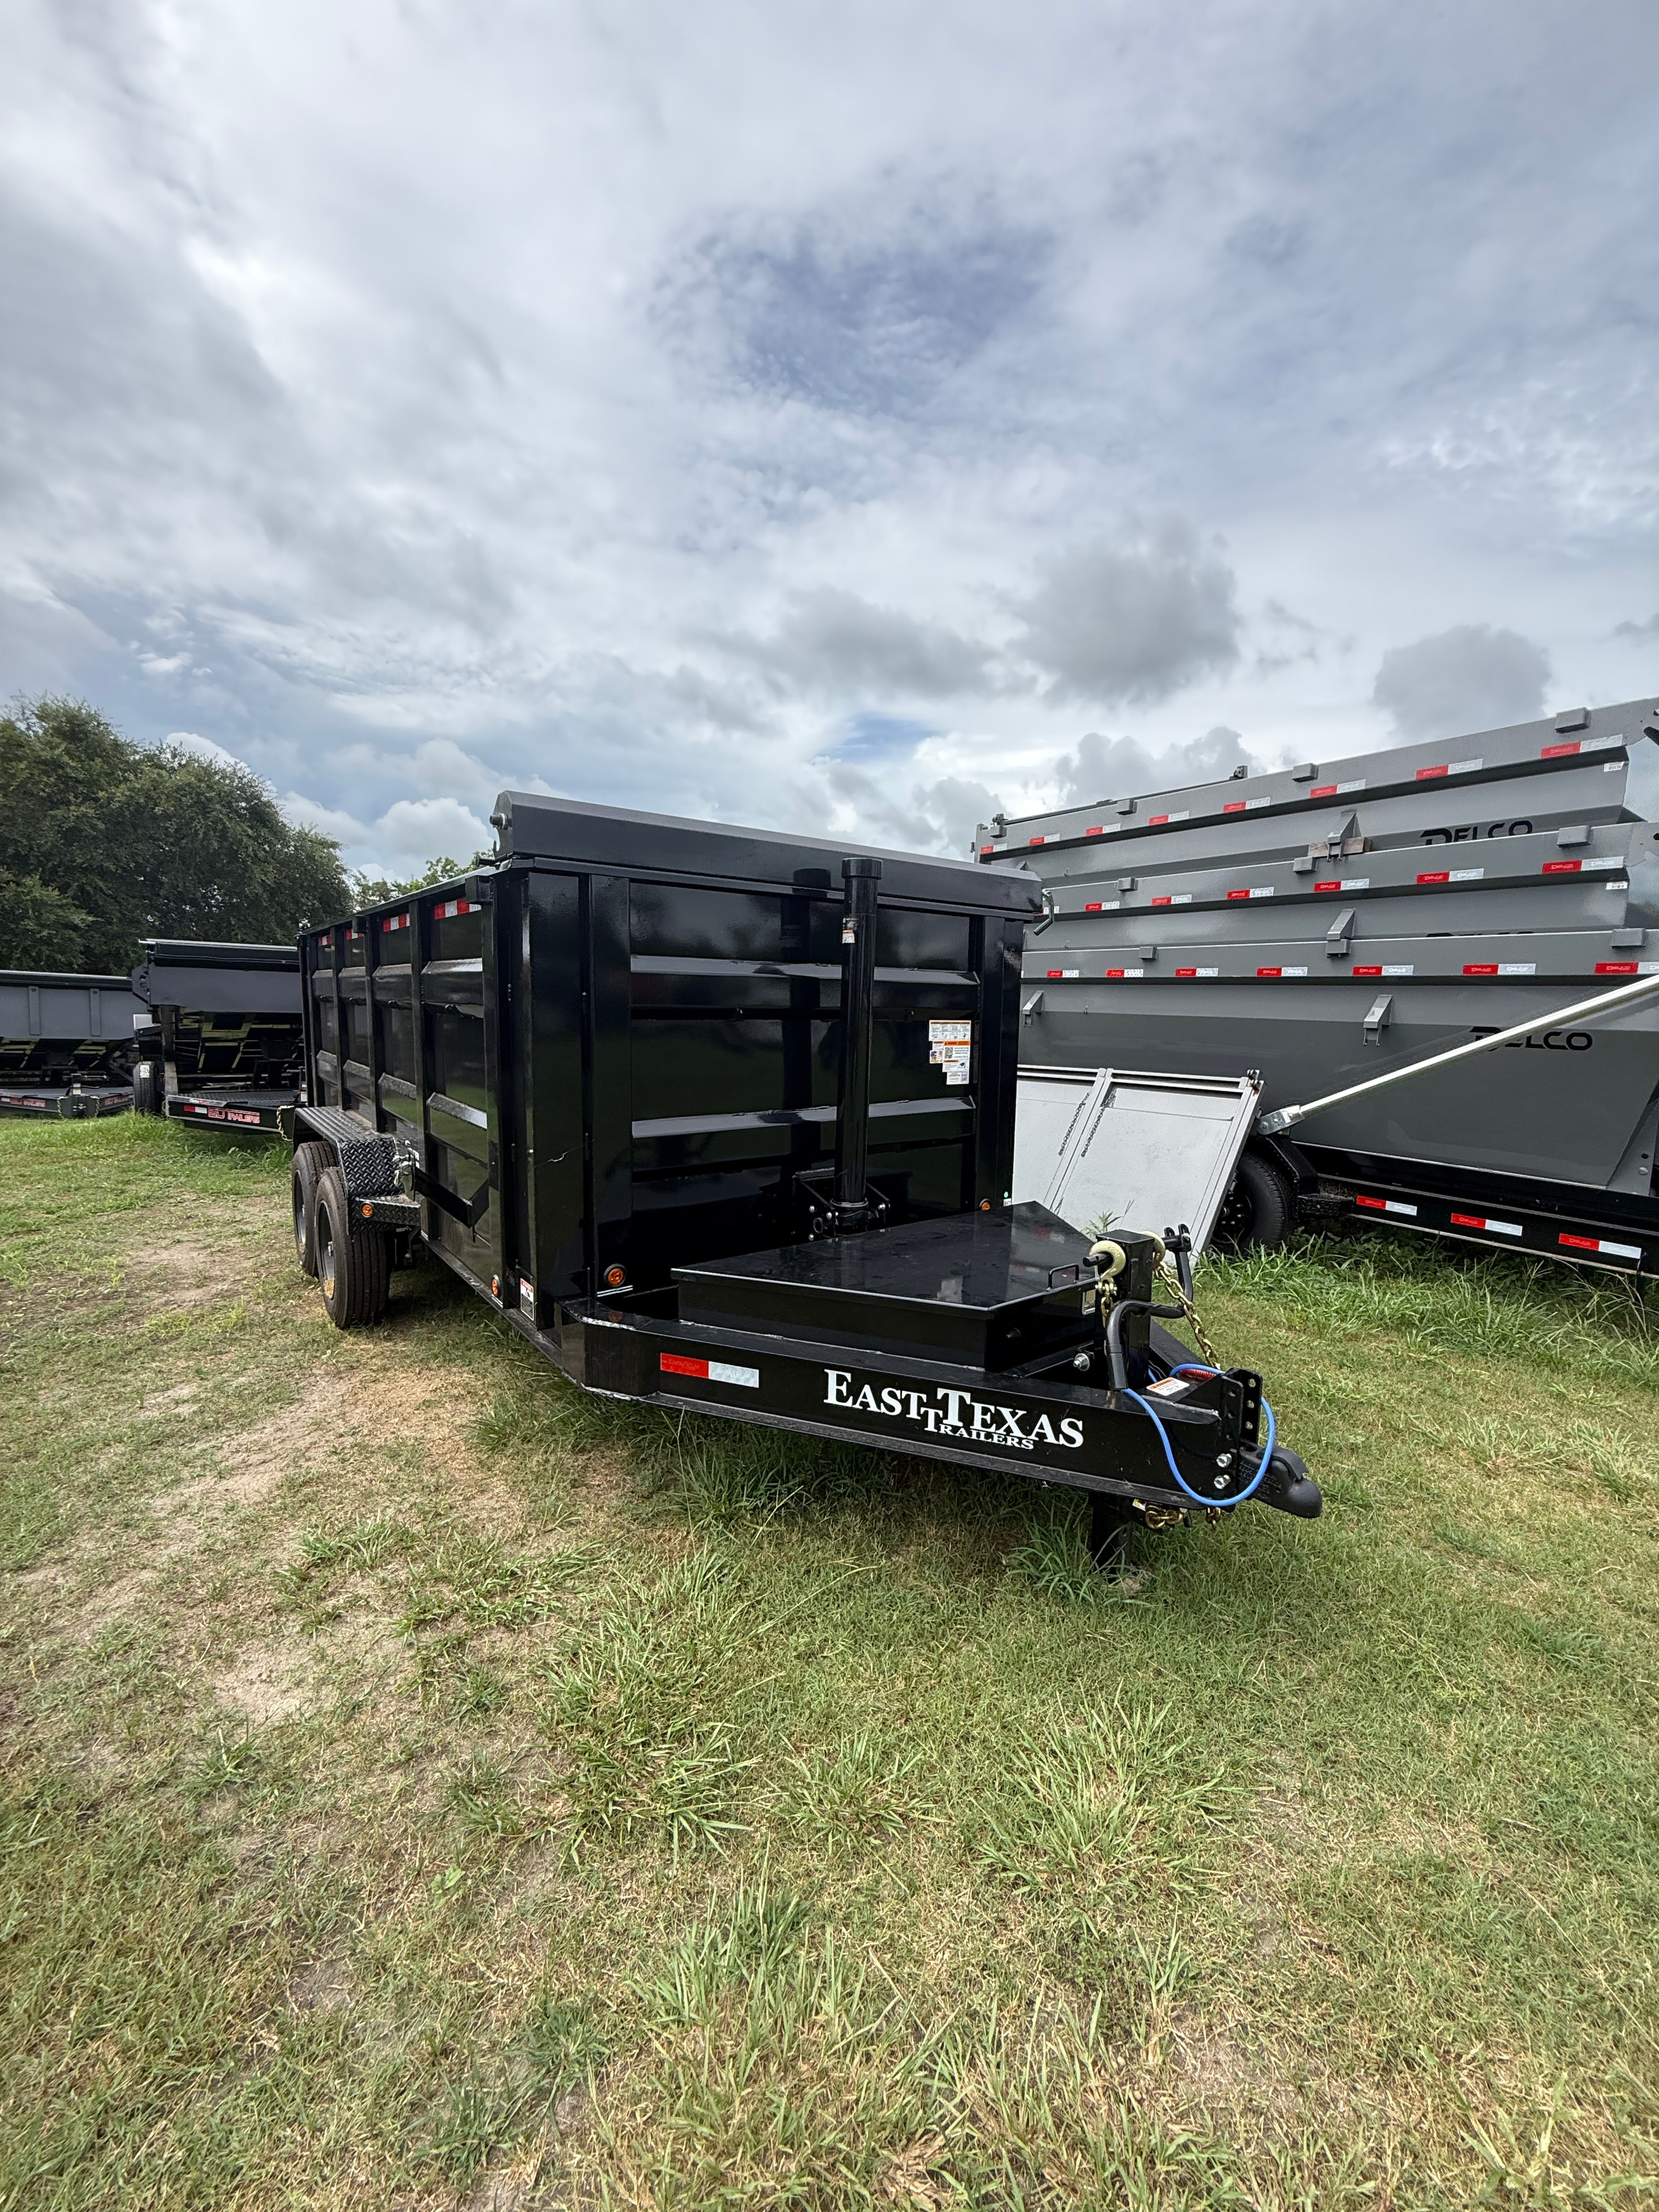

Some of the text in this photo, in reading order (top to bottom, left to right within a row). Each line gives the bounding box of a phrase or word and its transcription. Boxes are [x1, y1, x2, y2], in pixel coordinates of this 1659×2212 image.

[225, 1109, 260, 1124] TRAILERS
[824, 1369, 1084, 1448] EAST TEXAS
[920, 1406, 1035, 1450] TRAILERS
